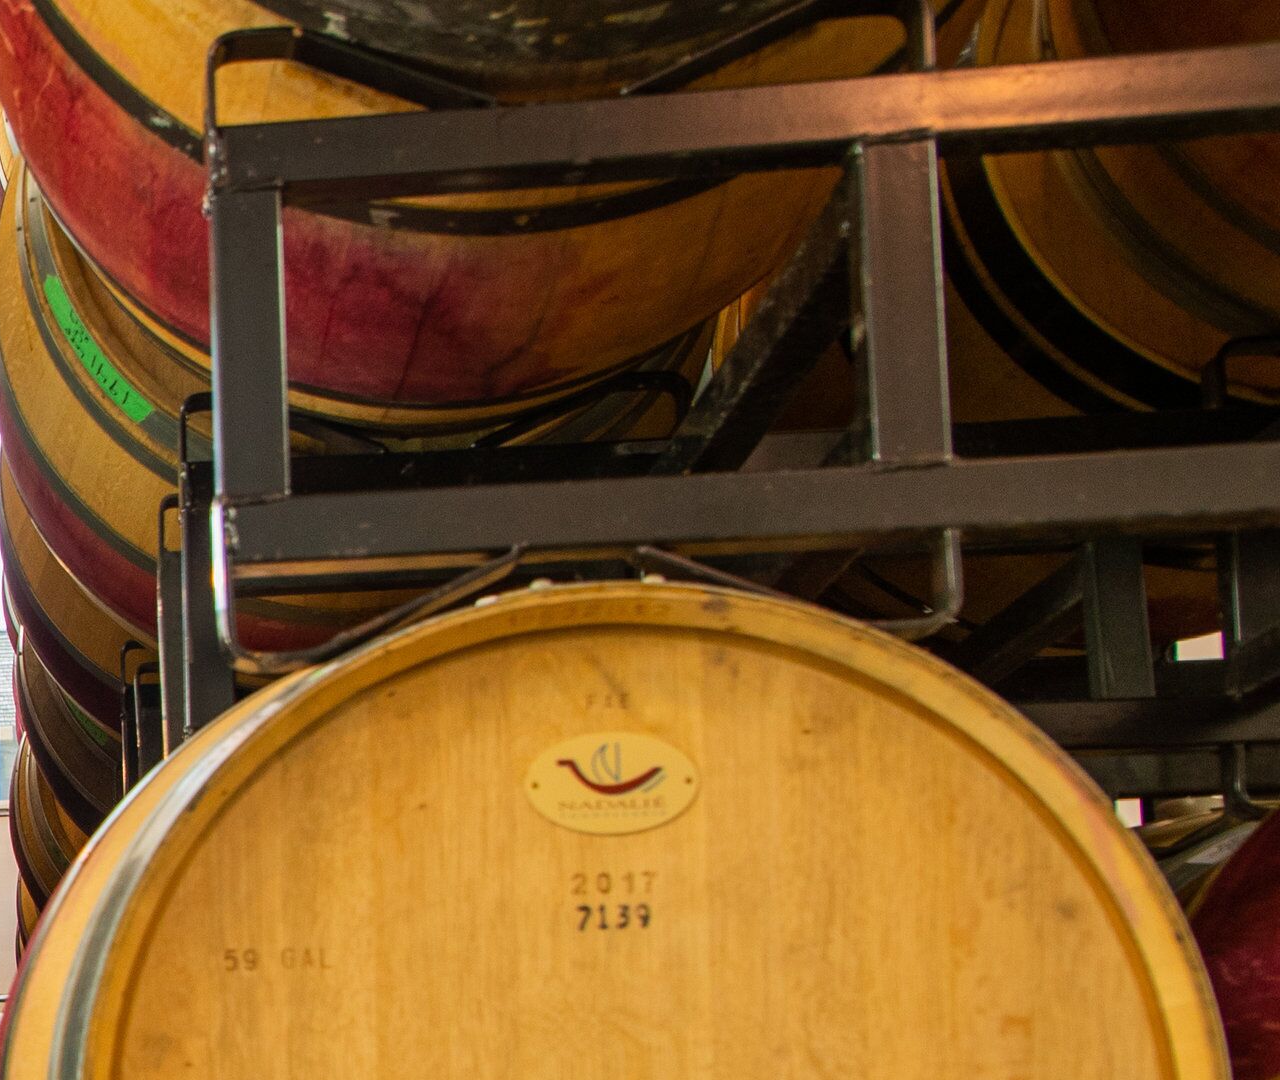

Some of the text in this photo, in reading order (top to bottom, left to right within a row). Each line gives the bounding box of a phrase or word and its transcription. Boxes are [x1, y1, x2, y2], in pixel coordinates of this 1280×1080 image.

[570, 871, 658, 896] 2017
[576, 902, 652, 932] 7139
[223, 946, 332, 972] 59 GAL
